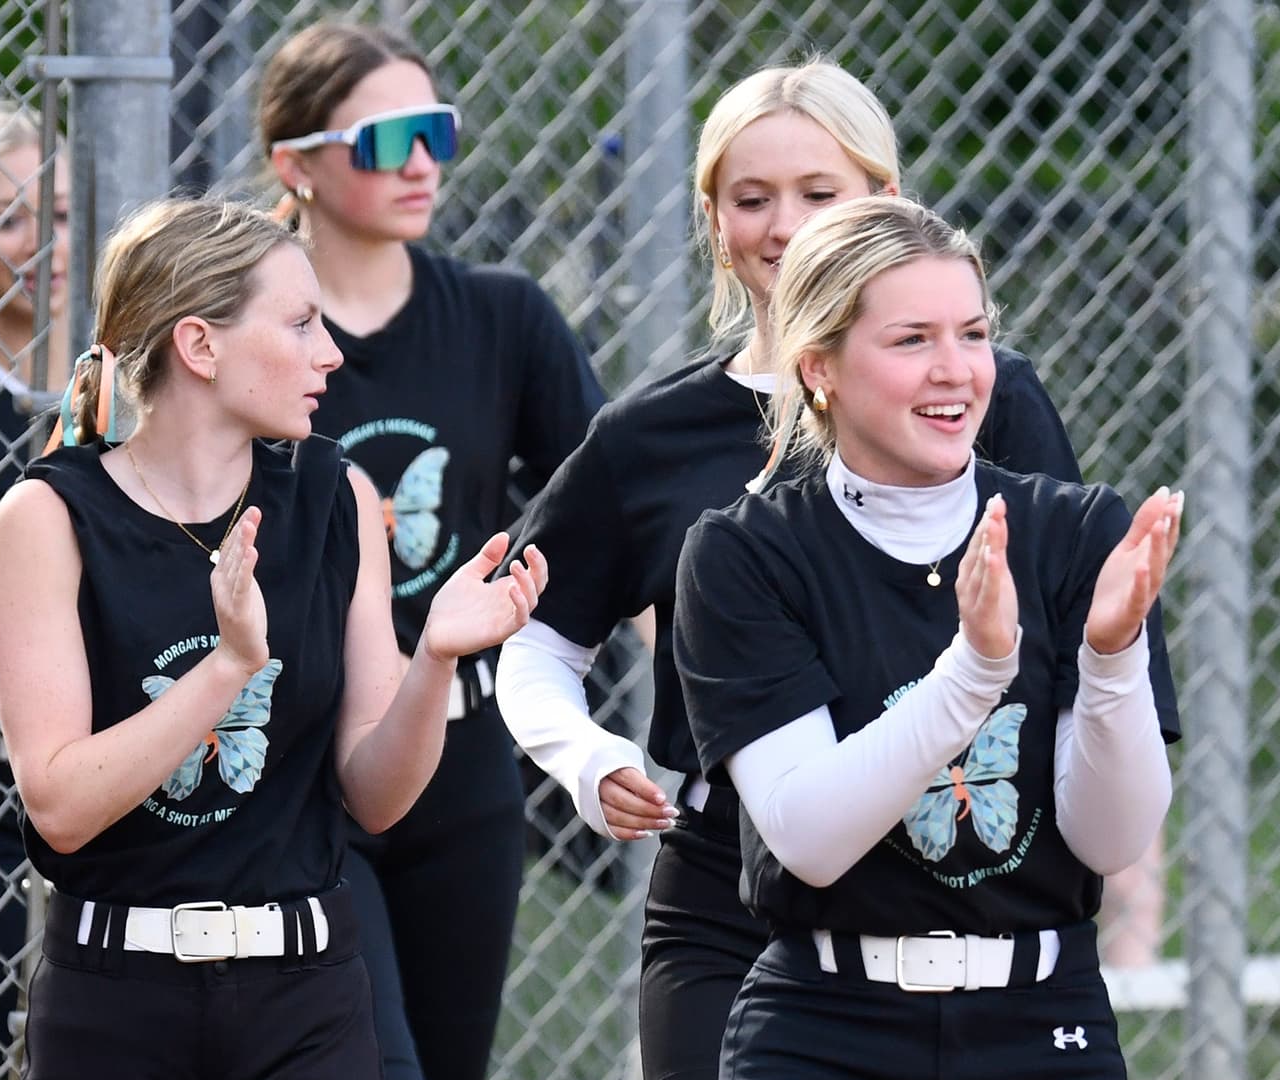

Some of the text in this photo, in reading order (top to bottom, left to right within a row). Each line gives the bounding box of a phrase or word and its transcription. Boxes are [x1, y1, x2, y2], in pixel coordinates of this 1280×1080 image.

[153, 635, 209, 670] MORGAN'S
[155, 806, 167, 819] A
[166, 809, 199, 827] SHOT
[199, 812, 214, 825] AT
[1017, 807, 1043, 856] HEALTH
